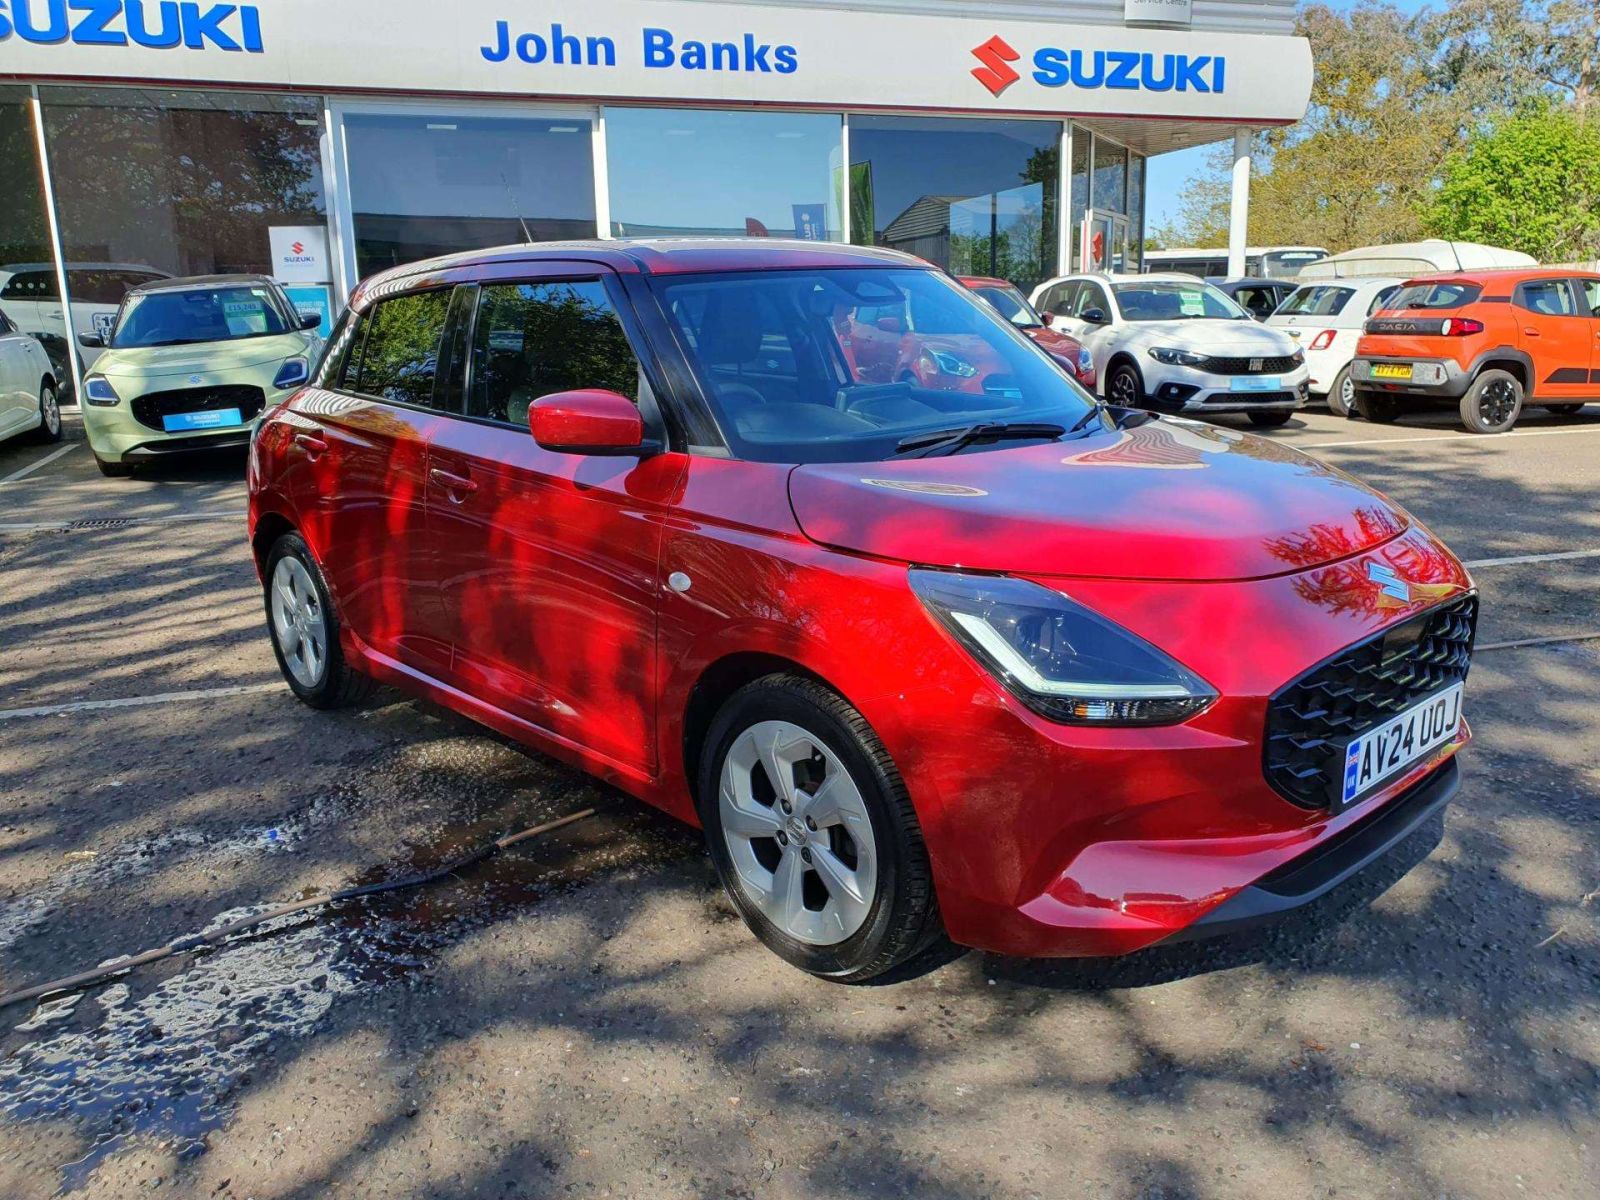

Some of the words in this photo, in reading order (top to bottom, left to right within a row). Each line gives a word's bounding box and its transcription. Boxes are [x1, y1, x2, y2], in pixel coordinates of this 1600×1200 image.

[0, 0, 264, 53] UZUKI
[480, 20, 616, 67] John
[642, 27, 798, 74] Banks
[1032, 48, 1226, 94] SUZUKI
[1378, 323, 1417, 331] DACIA
[1360, 715, 1415, 785] AV24
[1420, 691, 1459, 747] UOJ
